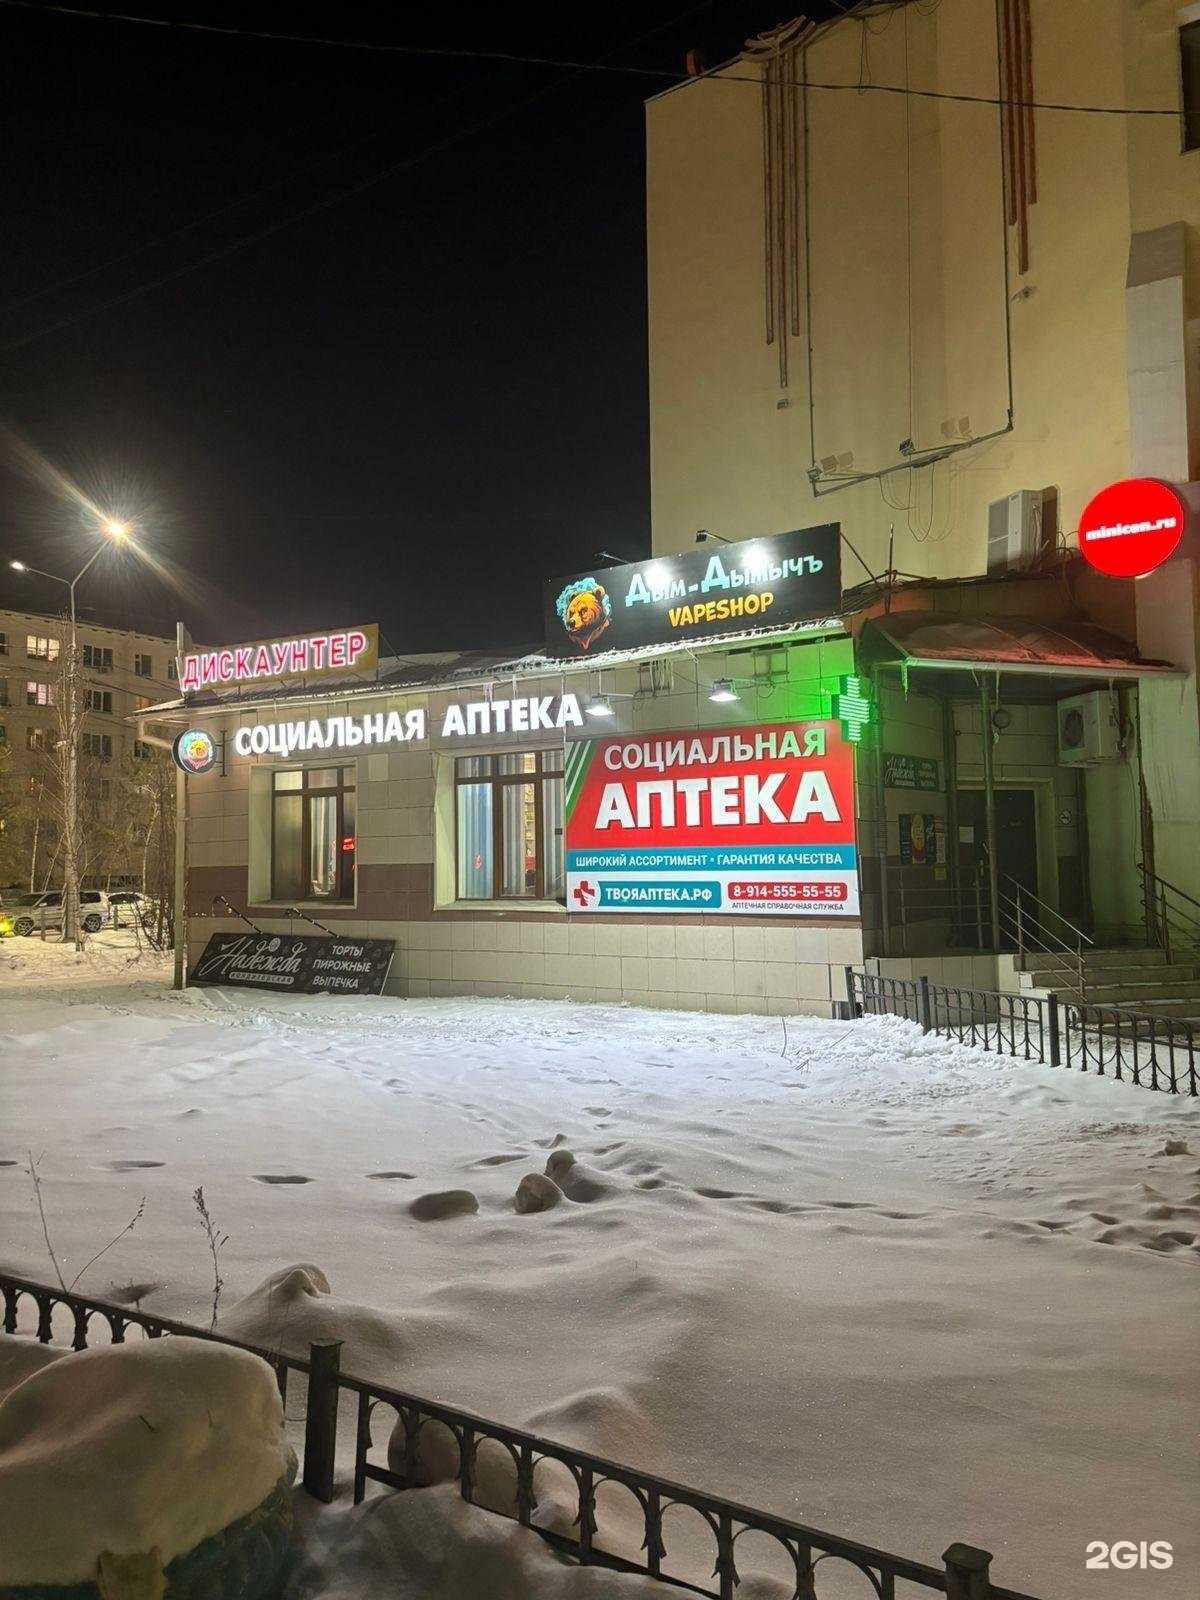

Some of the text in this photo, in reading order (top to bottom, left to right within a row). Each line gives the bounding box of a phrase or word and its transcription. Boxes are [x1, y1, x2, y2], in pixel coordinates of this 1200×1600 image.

[668, 592, 775, 629] VAPESHOP
[182, 631, 367, 692] ДИСКАУНТЕР
[234, 693, 584, 757] СОЦИАЛЬНАЯ АПТЕКА
[604, 728, 826, 773] СОЦИАЛЬНАЯ
[594, 770, 842, 830] АПТЕКА
[576, 853, 843, 867] ШИРОКИЙ АССОРТИМЕНТ ГАРАНТИЯ КАЧЕСТВА
[605, 885, 841, 901] ТВОЯАПТЕКА.РФ 8-914-555-55-55
[732, 902, 767, 910] АПТЕЧНАЯ
[813, 903, 844, 911] СЛУЖБА
[332, 945, 364, 956] ТОРТЫ
[312, 958, 372, 973] ПИРОЖНЫЕ
[312, 975, 360, 989] ВЫПЕЧКА
